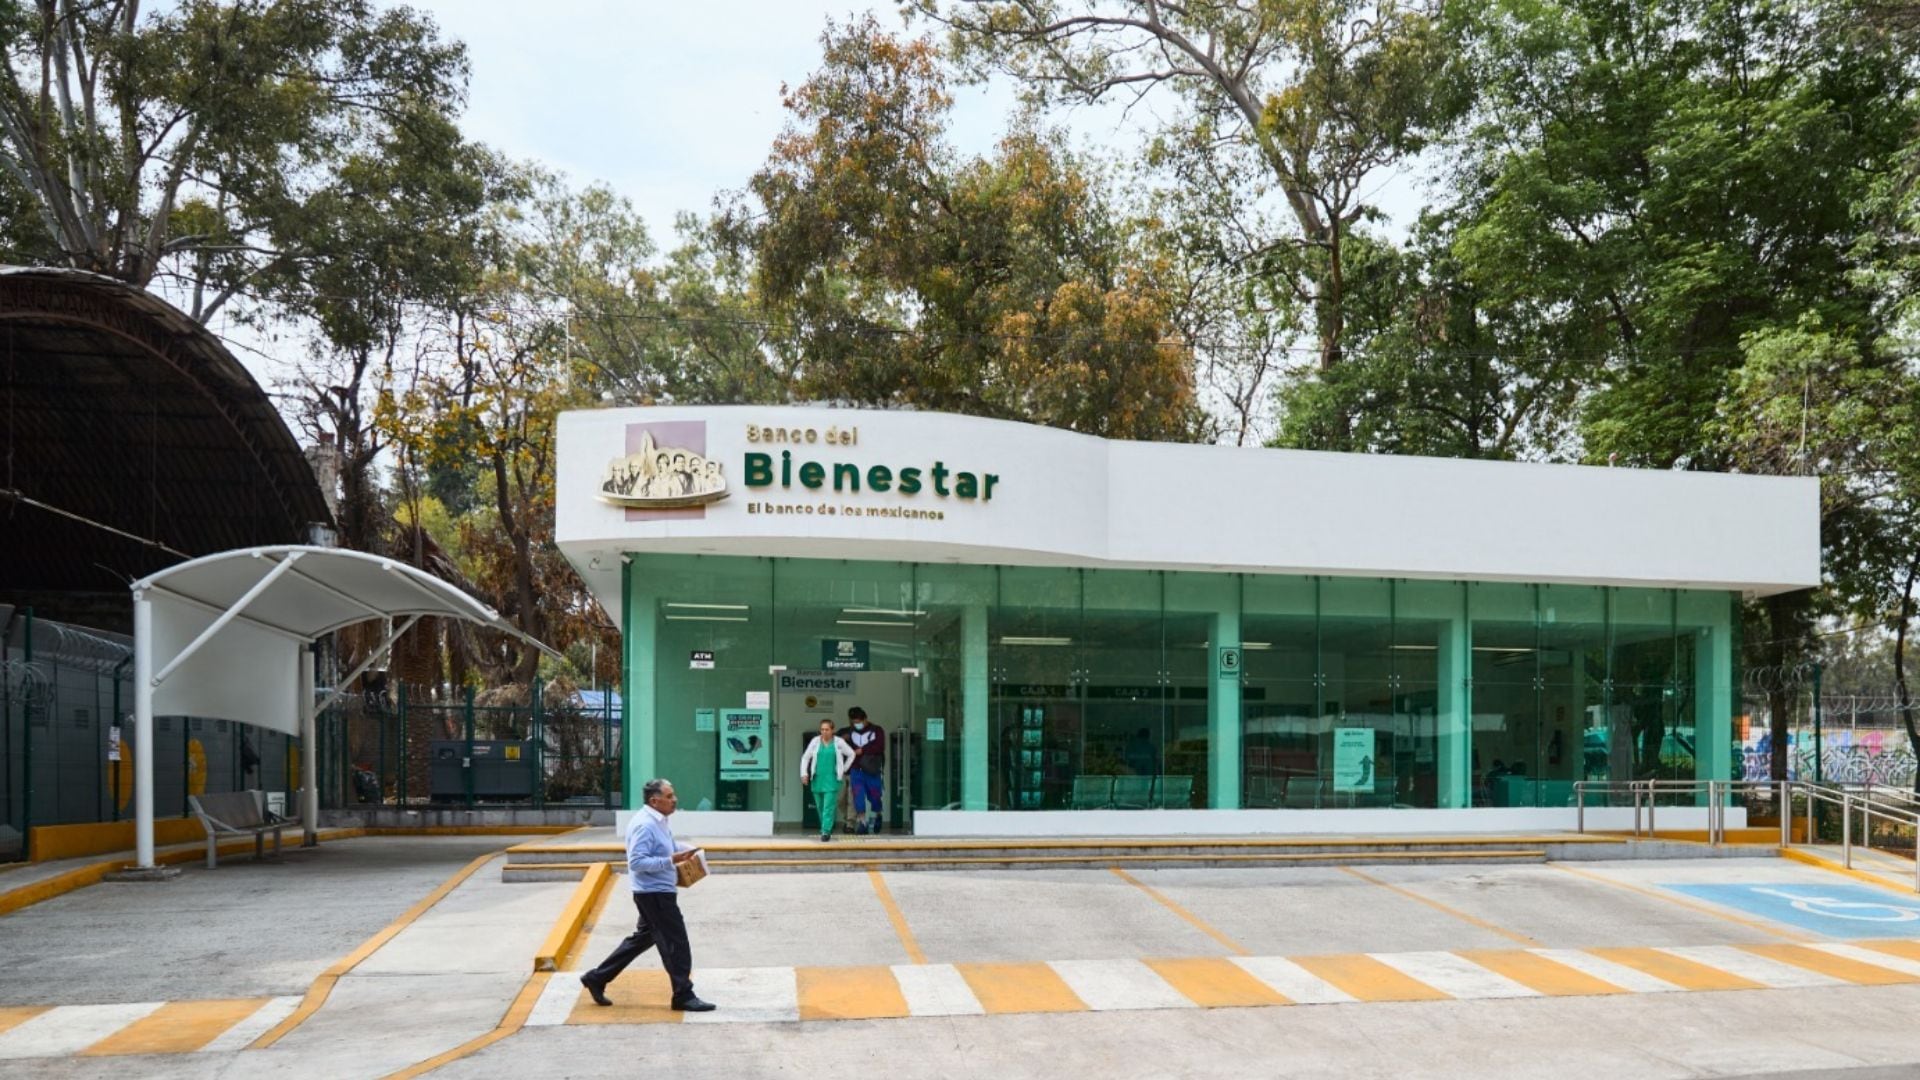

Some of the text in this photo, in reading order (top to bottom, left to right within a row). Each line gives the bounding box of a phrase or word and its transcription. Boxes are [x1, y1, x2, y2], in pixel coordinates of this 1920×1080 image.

[747, 424, 857, 446] Banco del
[744, 450, 999, 503] Bienestar
[748, 502, 944, 520] El banco de los mexicanos
[694, 652, 712, 660] ATM
[1226, 653, 1234, 665] E
[781, 676, 851, 689] Bienestar
